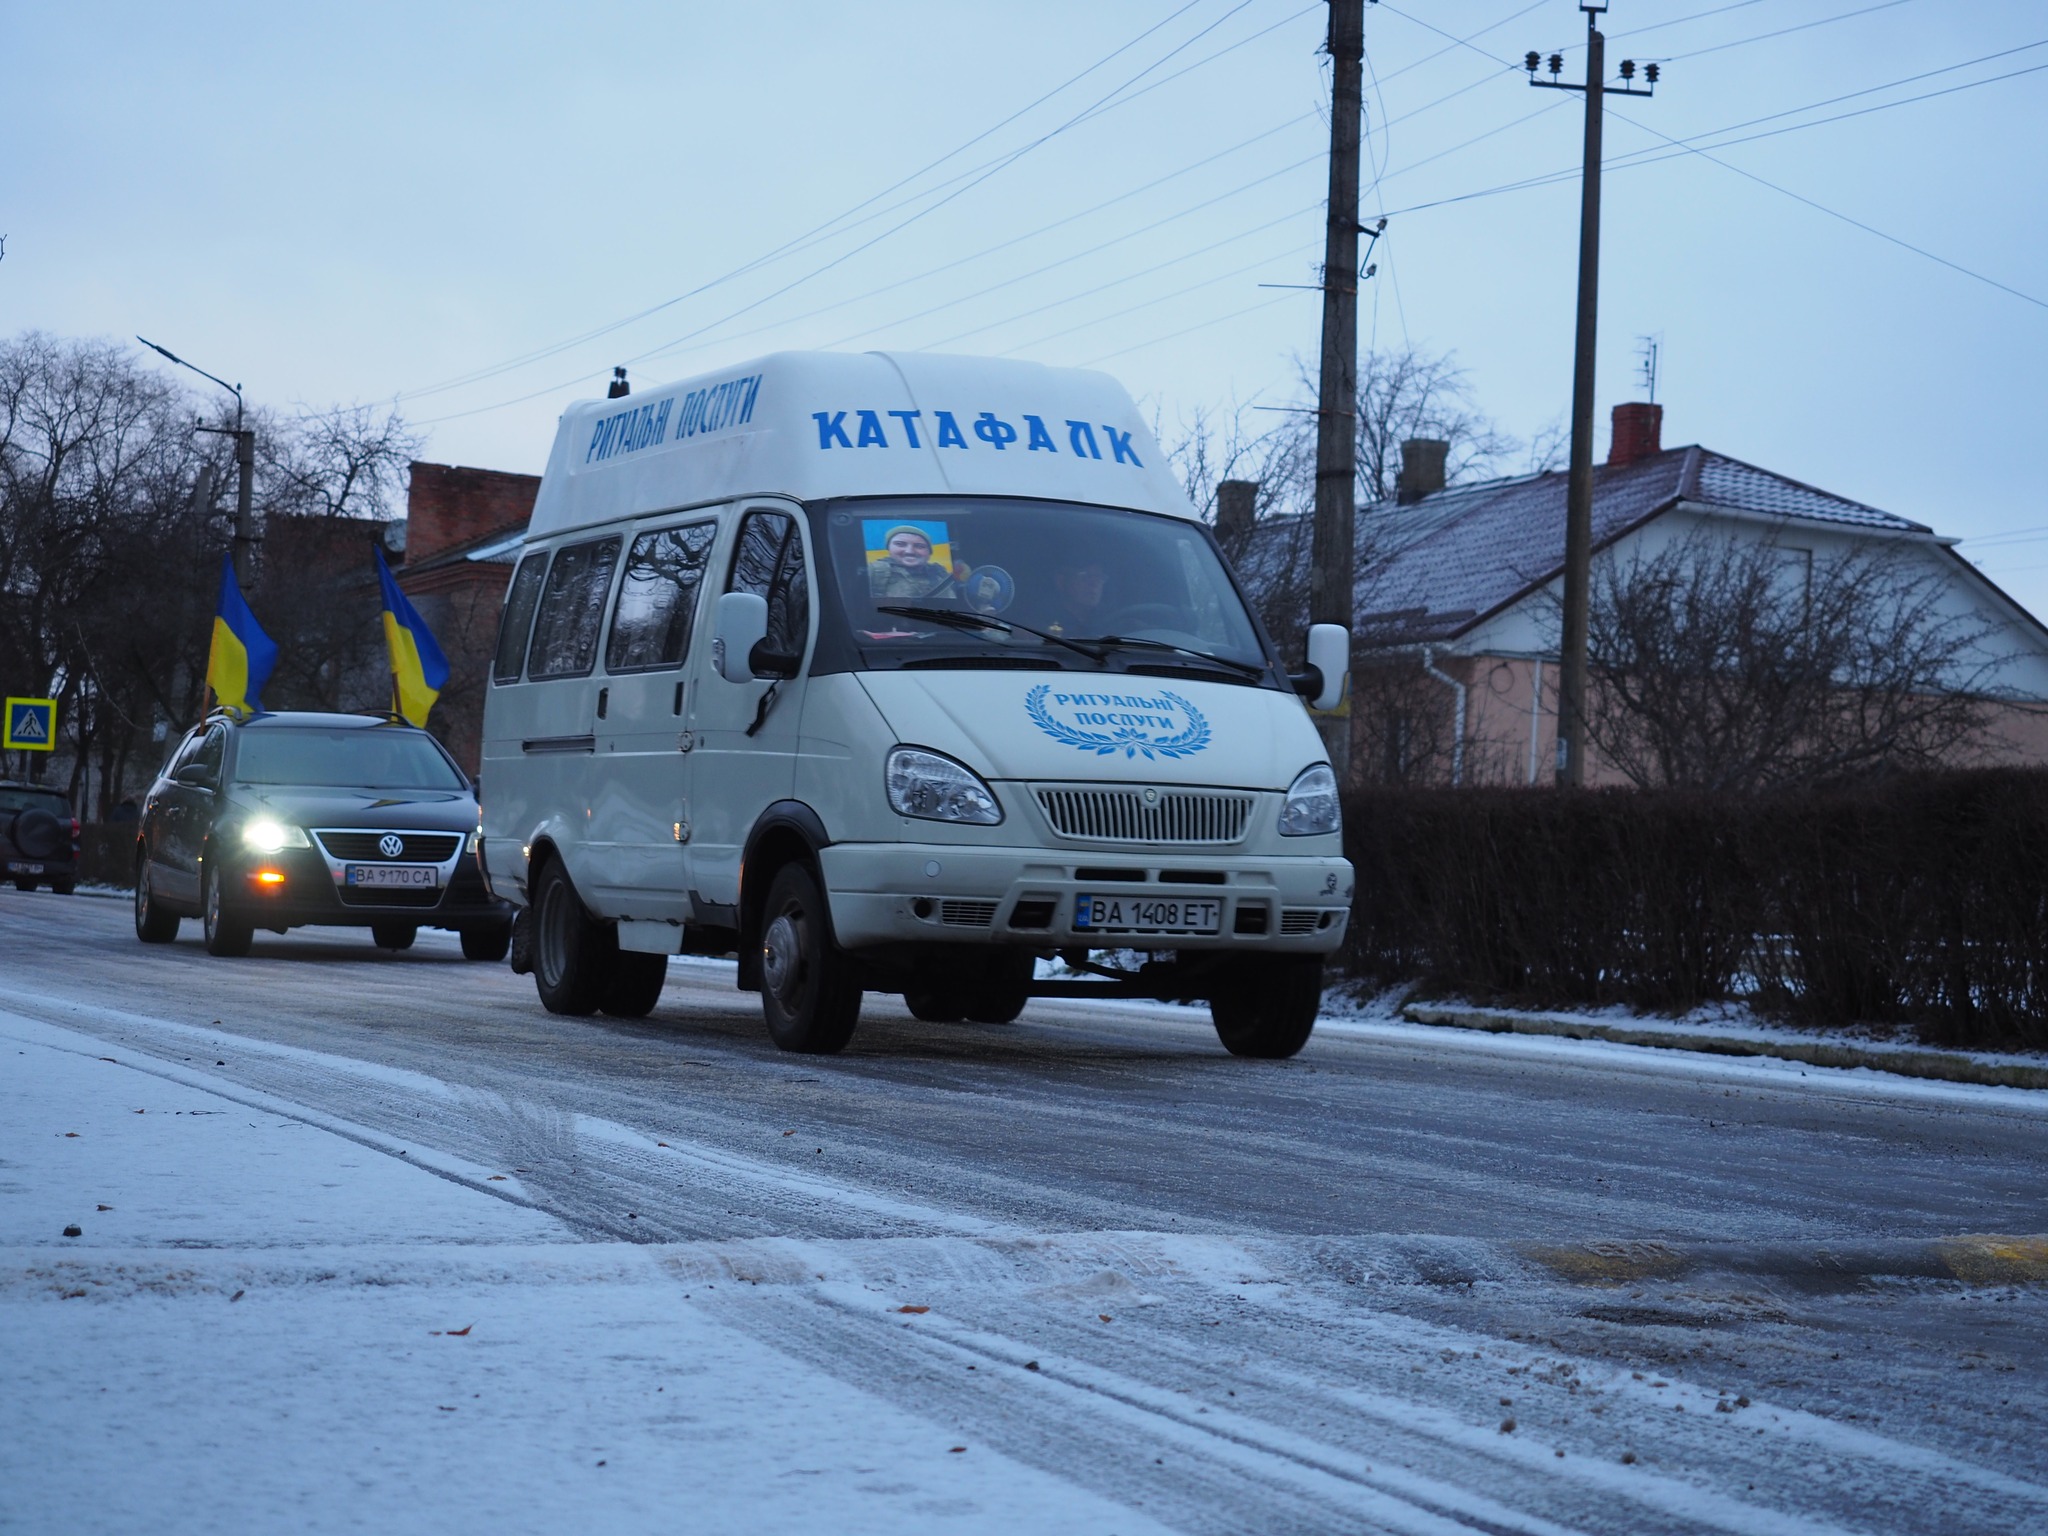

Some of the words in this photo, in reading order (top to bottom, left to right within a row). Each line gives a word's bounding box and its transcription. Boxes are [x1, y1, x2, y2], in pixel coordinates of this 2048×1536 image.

[586, 396, 673, 463] РИТУАЛЬНІ
[676, 374, 763, 440] ПОСЛУГИ
[812, 410, 1144, 468] КАТАФАЛК
[1054, 693, 1175, 711] РИТУАЛЬНІ
[1074, 713, 1174, 729] ПОСЛУГИ
[355, 869, 375, 882] BA
[379, 869, 409, 884] 9170
[413, 870, 432, 884] CA
[1091, 901, 1123, 924] BA
[1131, 903, 1179, 926] 1408
[1184, 904, 1216, 926] ET
